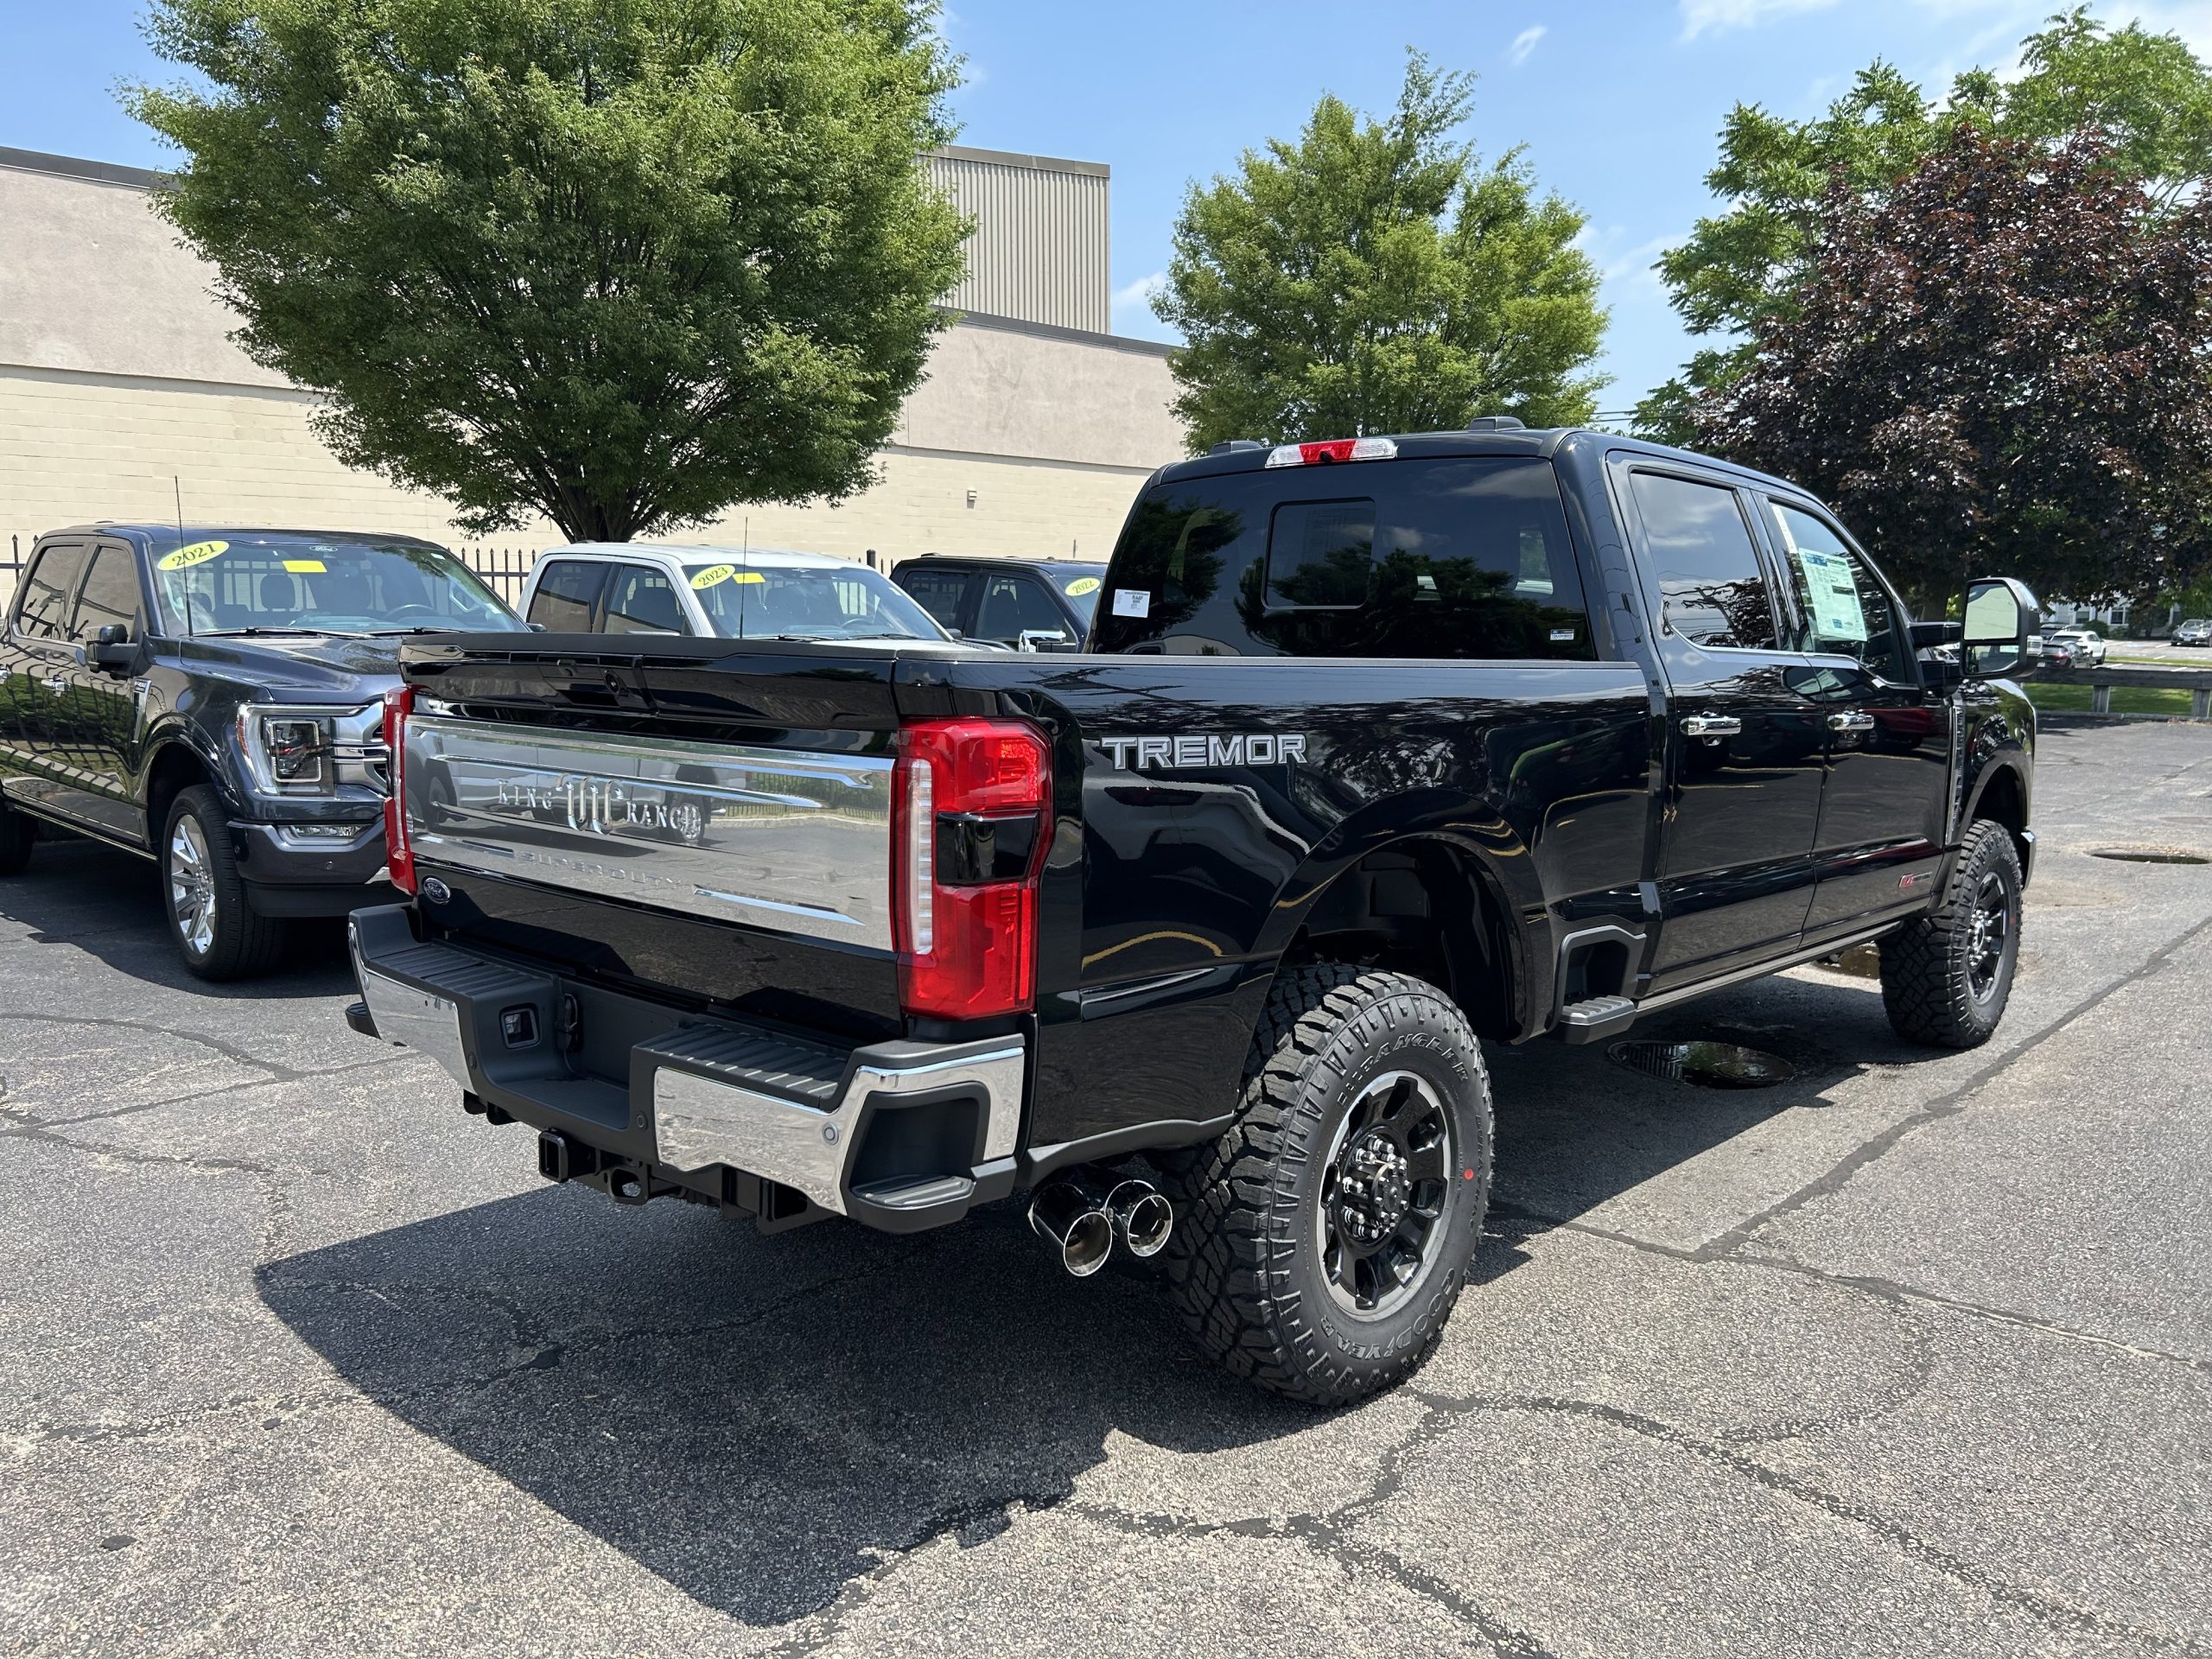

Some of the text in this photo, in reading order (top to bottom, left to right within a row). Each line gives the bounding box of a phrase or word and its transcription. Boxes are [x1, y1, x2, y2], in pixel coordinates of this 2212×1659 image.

[171, 543, 218, 567] 2021
[698, 567, 728, 586] 2023
[1071, 580, 1096, 594] 2022
[1101, 734, 1308, 770] TREMOR
[498, 779, 697, 830] KING RANCH
[1319, 1267, 1456, 1361] GOODYEAR
